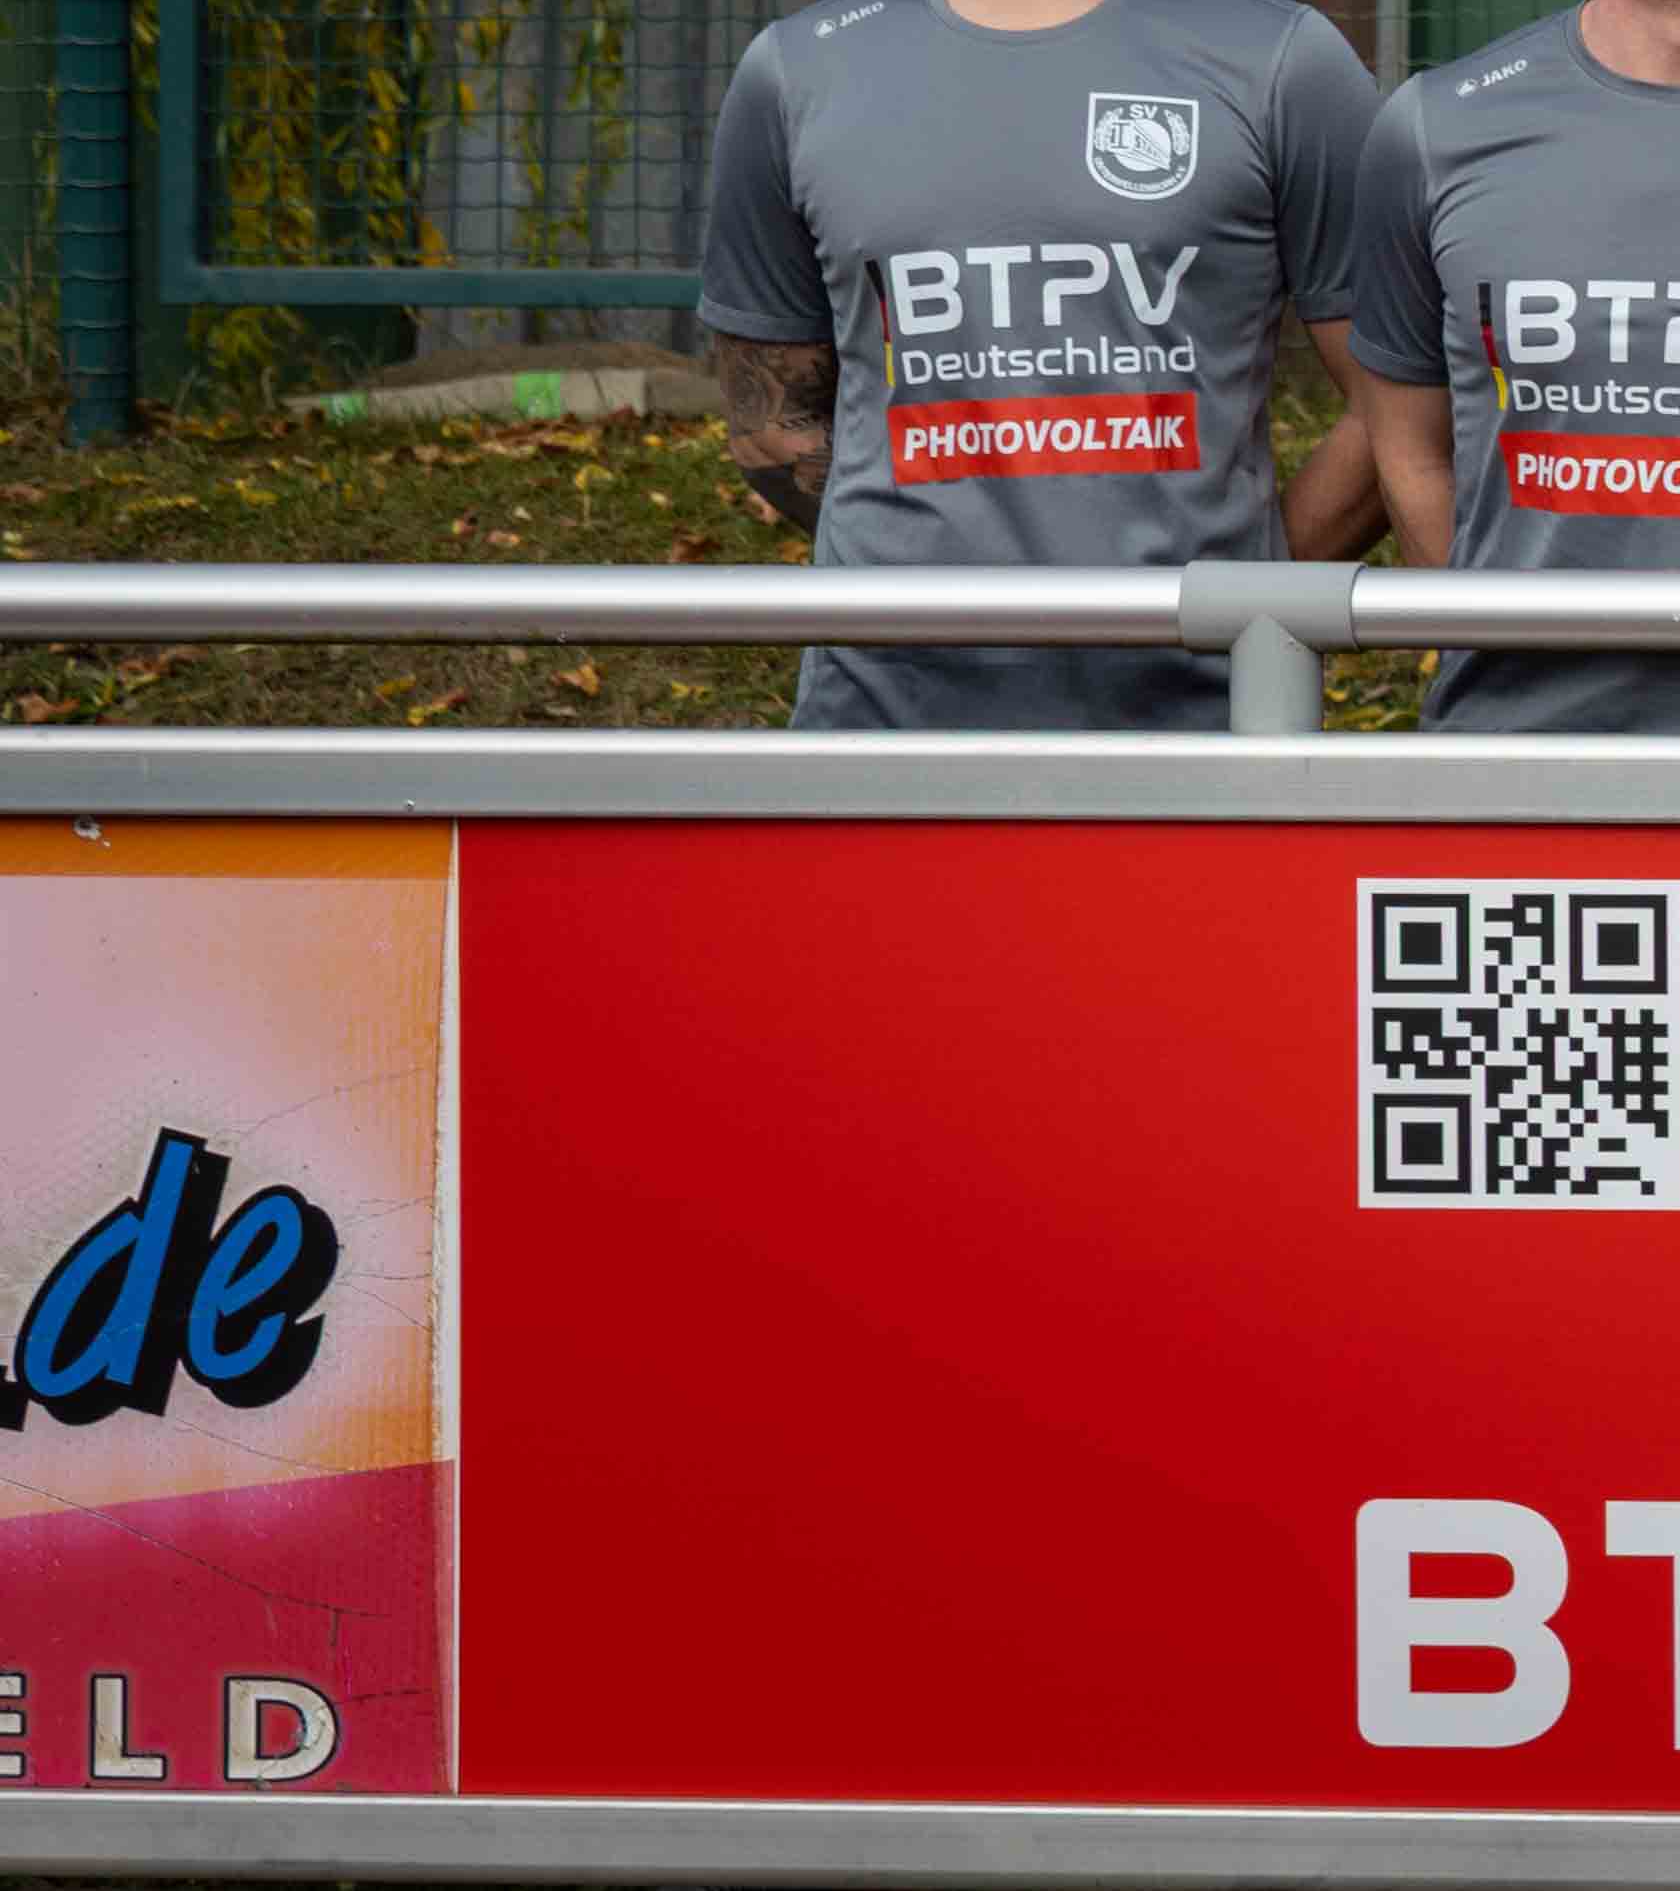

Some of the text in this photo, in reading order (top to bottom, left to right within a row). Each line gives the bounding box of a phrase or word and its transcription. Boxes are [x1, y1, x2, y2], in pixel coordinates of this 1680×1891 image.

[840, 1, 885, 27] JAKO
[1482, 59, 1528, 87] JAKO
[1129, 103, 1157, 119] SV
[889, 243, 1199, 336] BTPV
[901, 332, 1196, 385] Deutschland
[903, 416, 1185, 461] PHOTOVOLTAIK
[0, 1127, 338, 1431] de
